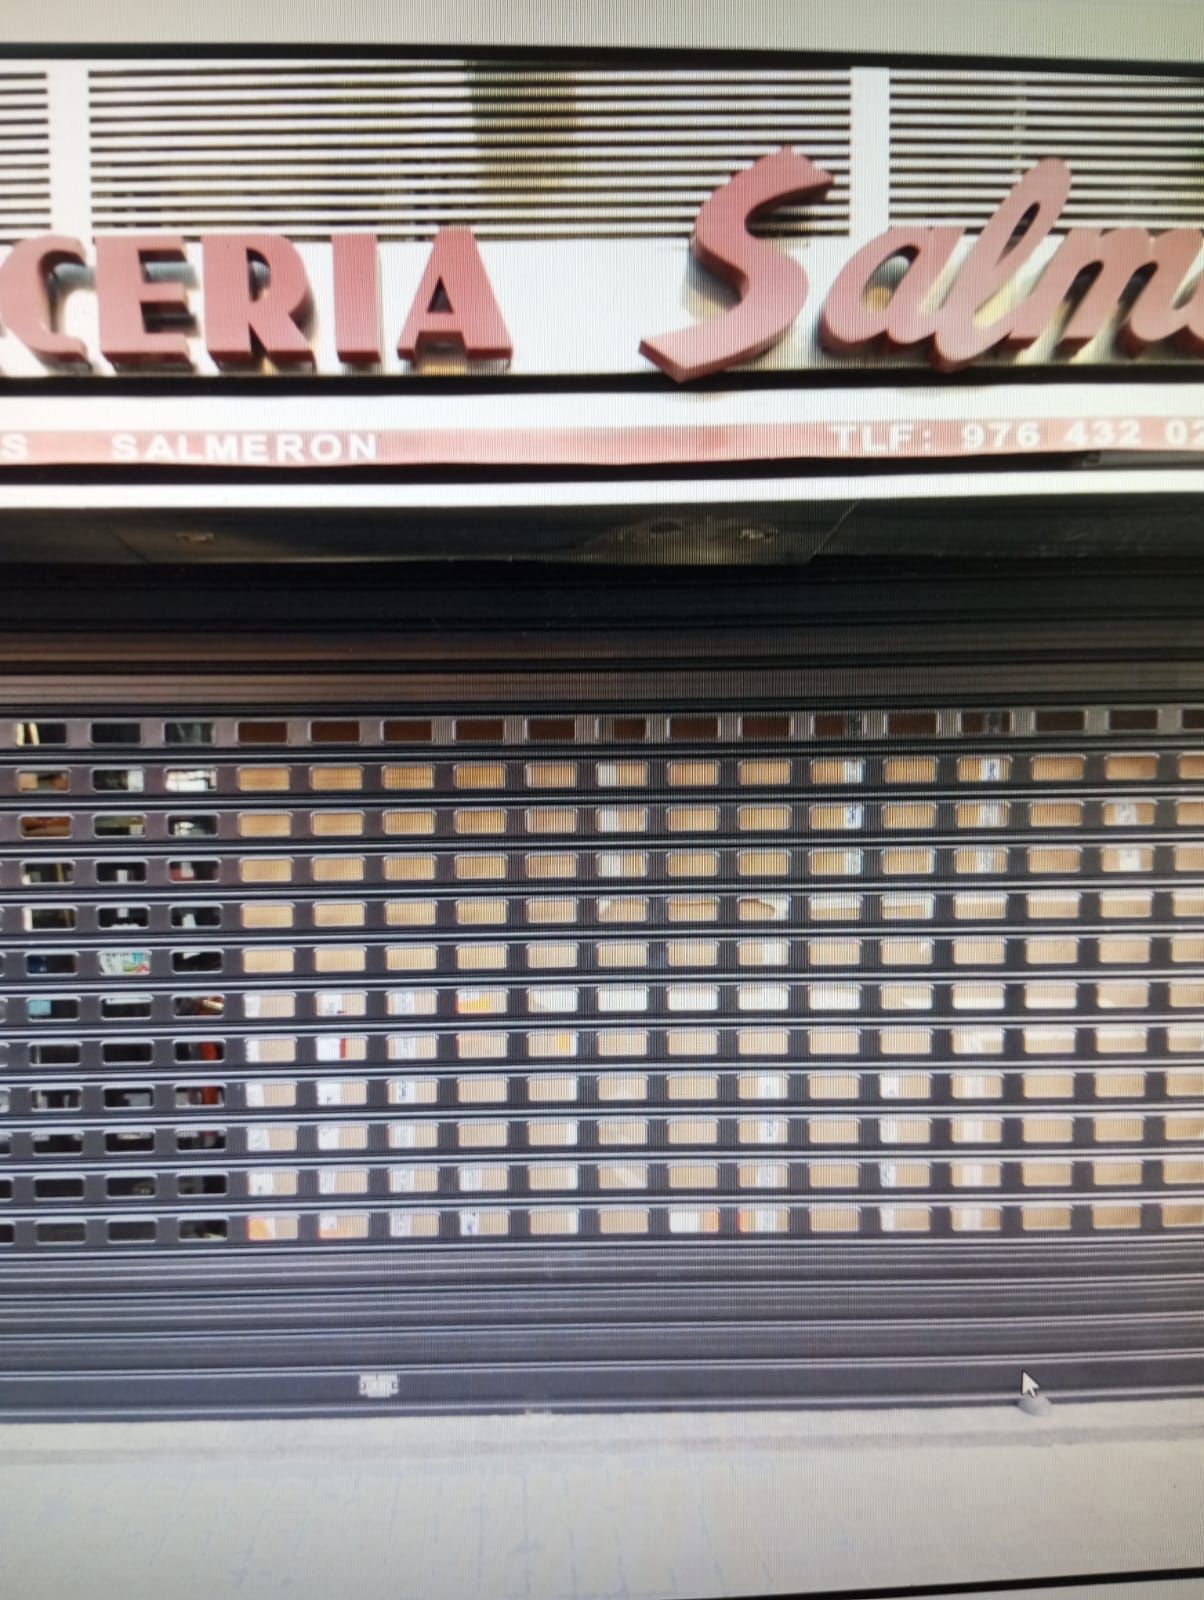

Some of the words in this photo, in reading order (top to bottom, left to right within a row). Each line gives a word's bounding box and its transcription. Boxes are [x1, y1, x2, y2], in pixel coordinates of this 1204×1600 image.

[0, 225, 514, 369] CERIA
[639, 145, 1204, 382] Salm
[110, 432, 378, 464] SALMERON
[831, 424, 934, 456] TLF:
[960, 424, 1041, 450] 976
[1065, 421, 1142, 448] 432
